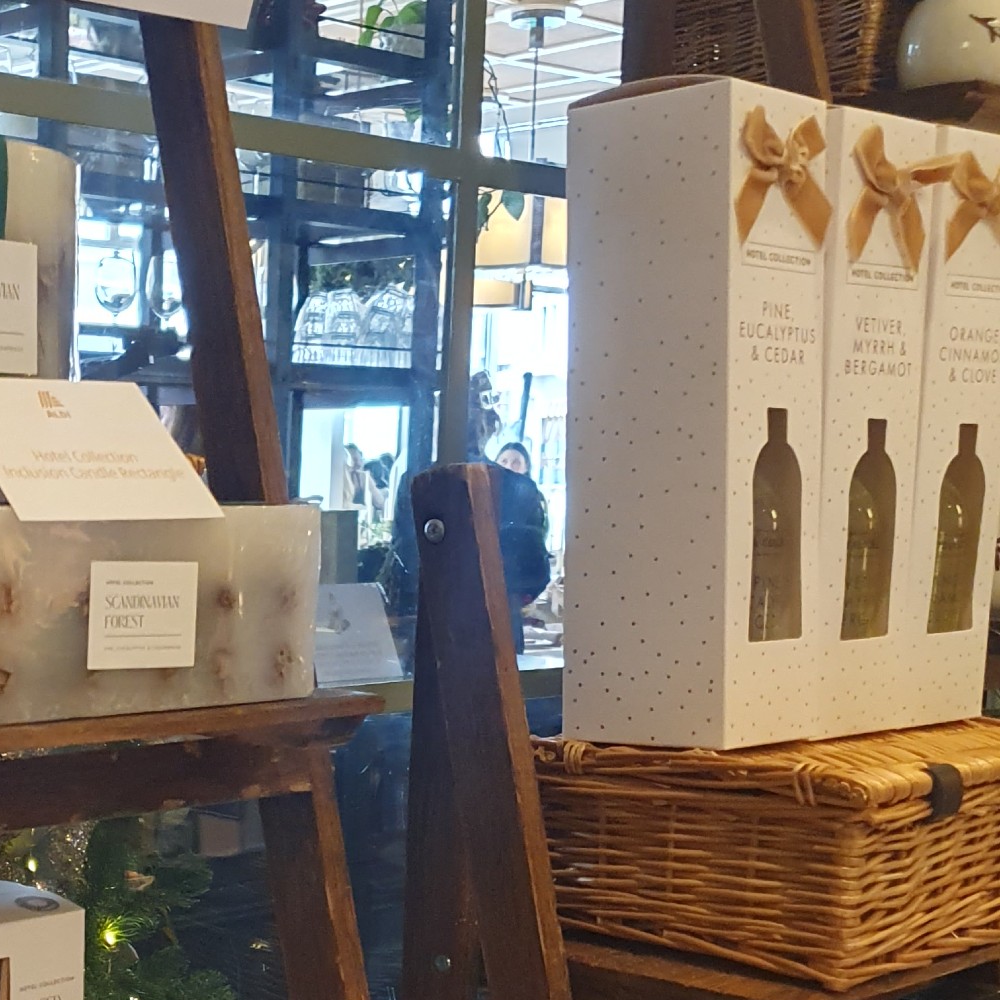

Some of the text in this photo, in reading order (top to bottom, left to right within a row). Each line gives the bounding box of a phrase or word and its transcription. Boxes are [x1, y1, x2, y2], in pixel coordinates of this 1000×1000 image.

[746, 250, 811, 267] HOTEL COLLECTION
[851, 269, 872, 280] HOTEL
[762, 301, 795, 322] PINE,
[739, 321, 817, 344] EUCALYPTUS
[856, 317, 906, 337] VETIVER,
[751, 346, 805, 365] & CEDAR
[853, 339, 907, 357] MYRRH &
[939, 346, 1000, 364] CINNAMO
[844, 360, 912, 378] BERGAMOT
[949, 367, 997, 384] & CLOVE
[46, 409, 72, 420] ALDI
[31, 450, 139, 464] Hotel Collection
[2, 465, 185, 483] Inclusion Candle Rectangle
[104, 594, 181, 610] SCANDINAVIAN
[104, 614, 145, 630] FOREST
